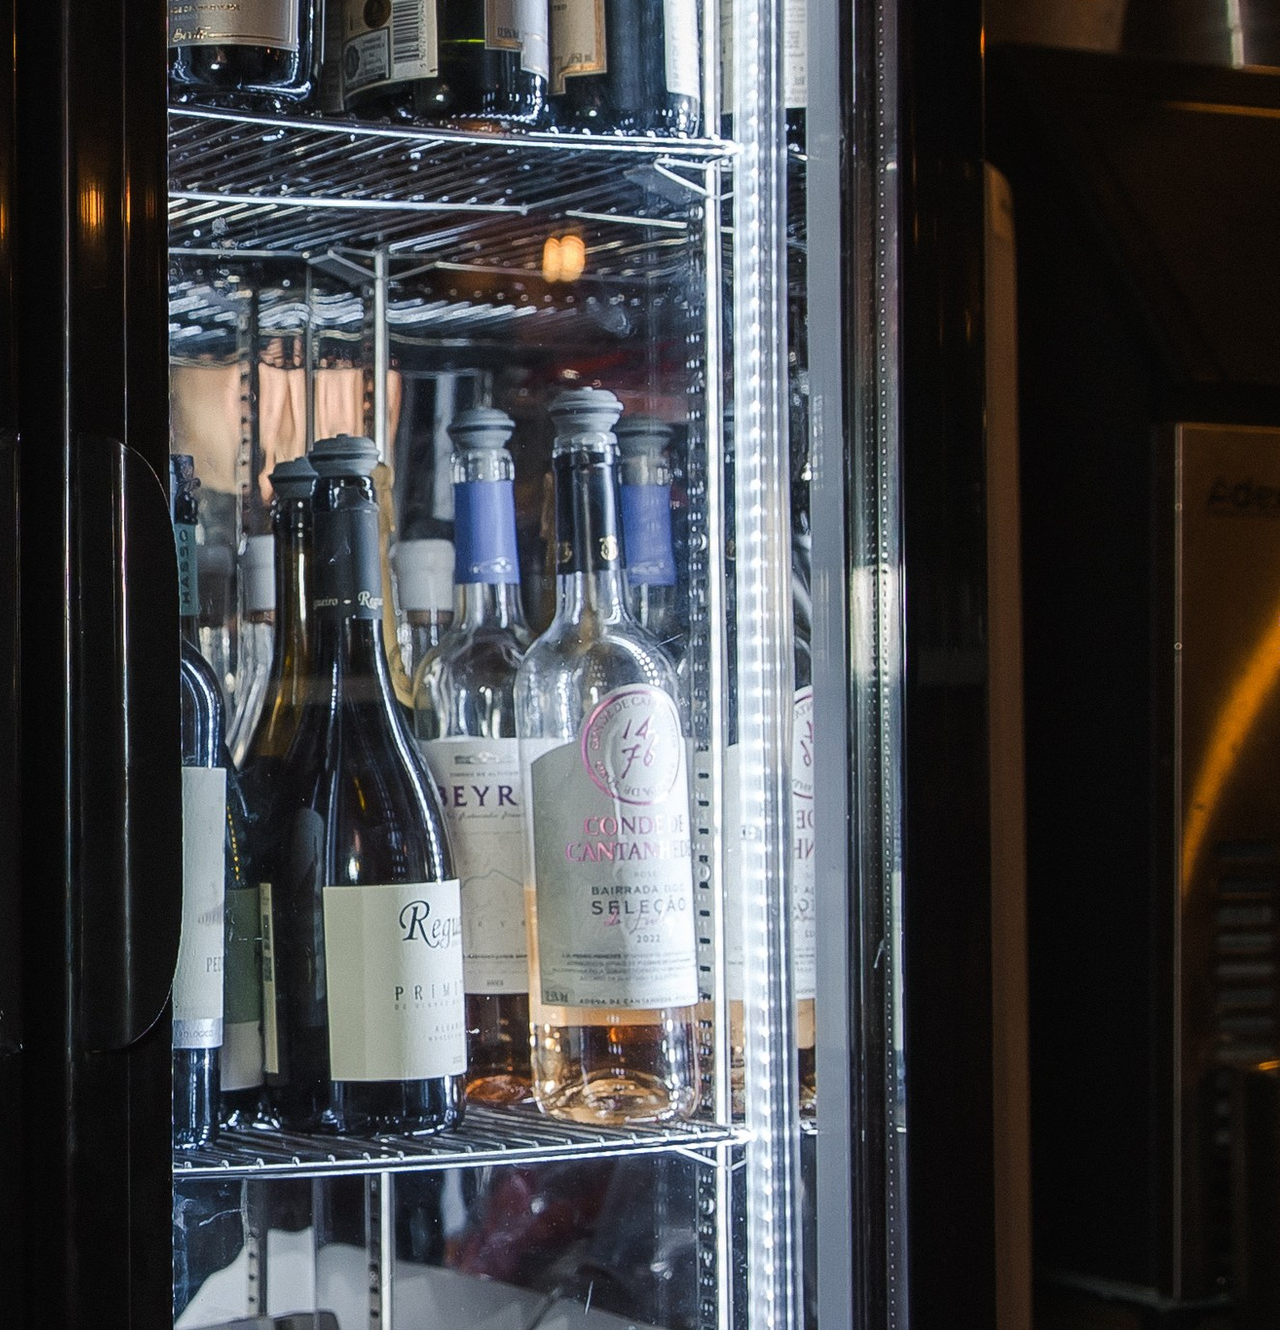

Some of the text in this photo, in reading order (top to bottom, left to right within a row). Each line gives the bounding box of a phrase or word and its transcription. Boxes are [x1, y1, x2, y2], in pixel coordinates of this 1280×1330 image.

[584, 815, 665, 836] CONDE
[592, 885, 659, 896] BAIRRADA
[592, 894, 686, 916] SELEÇÃO
